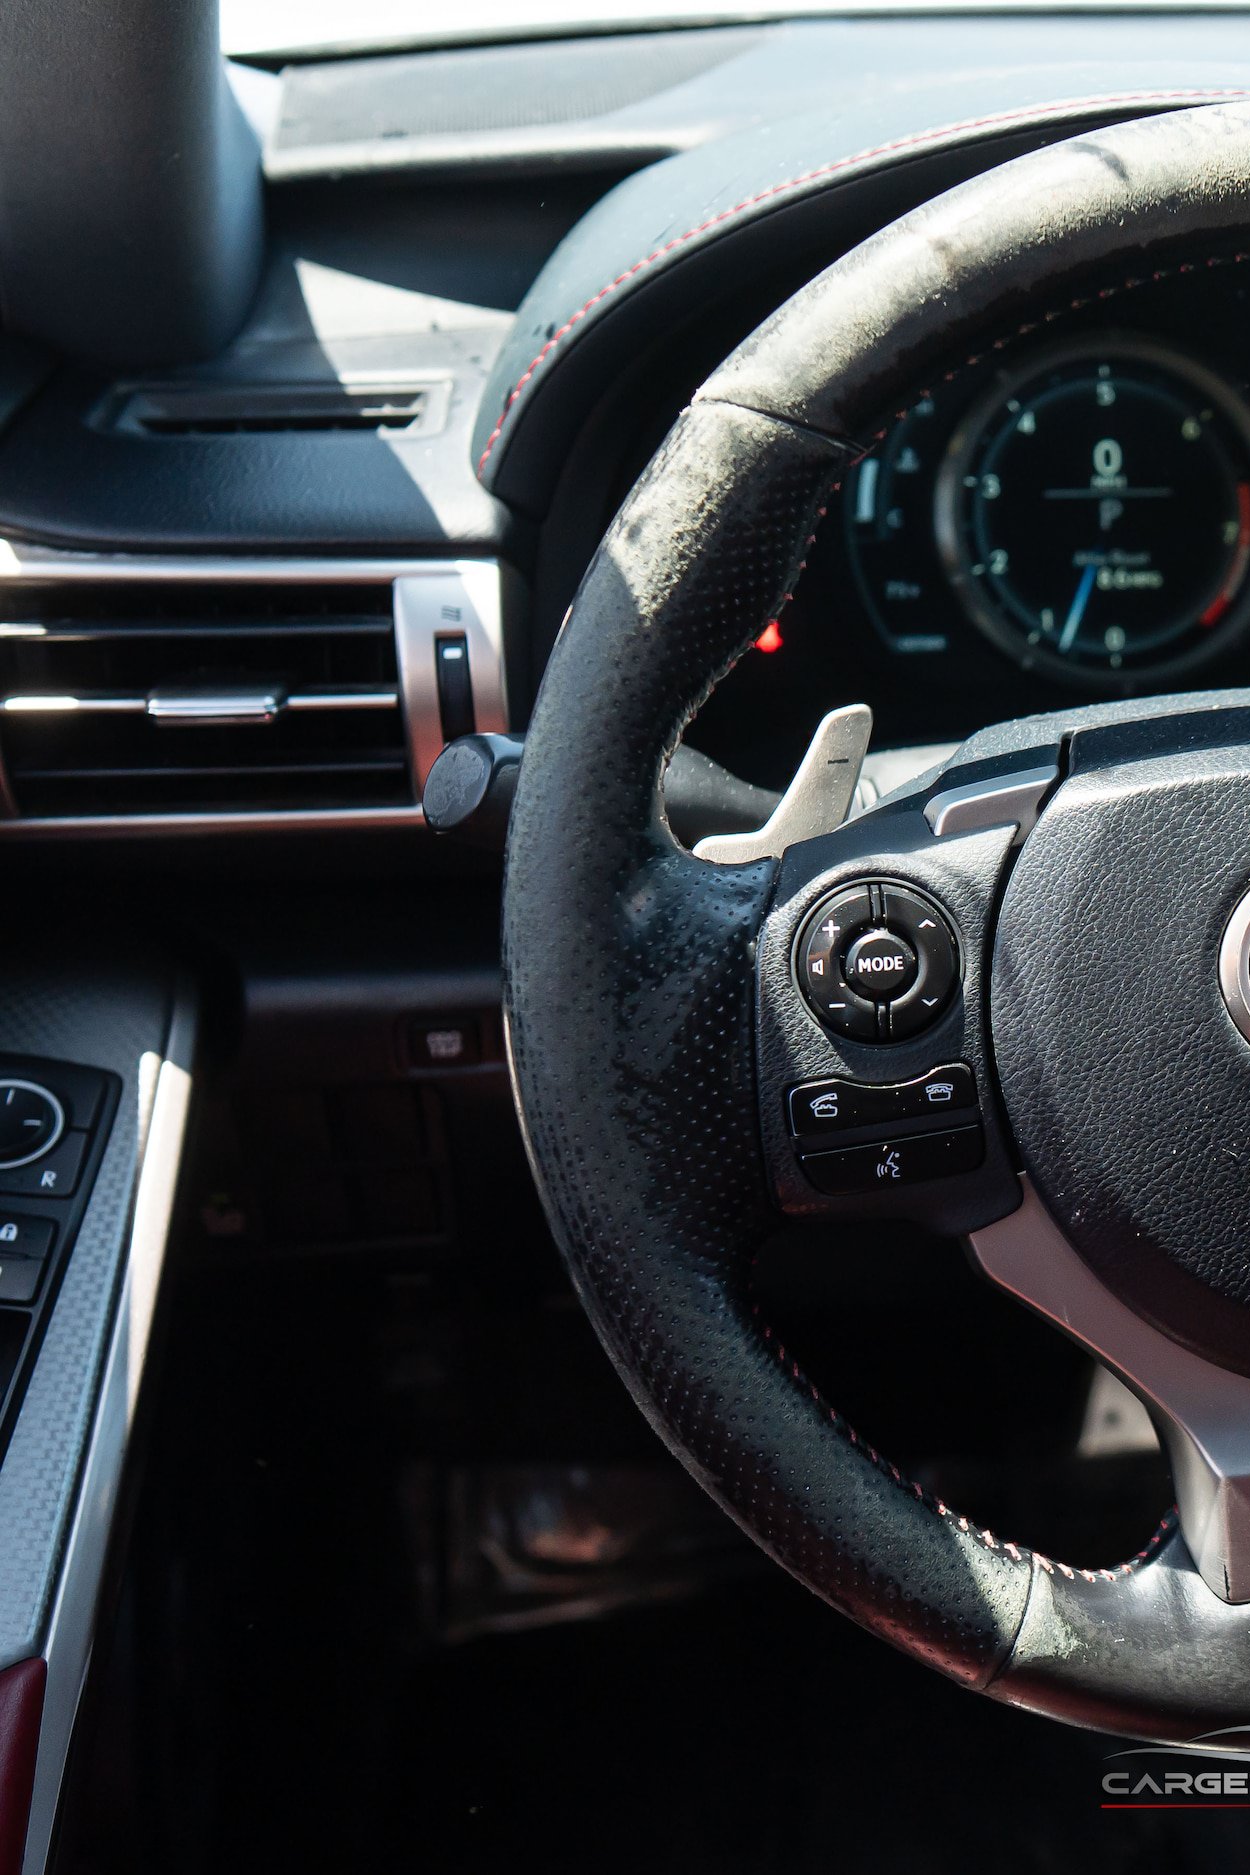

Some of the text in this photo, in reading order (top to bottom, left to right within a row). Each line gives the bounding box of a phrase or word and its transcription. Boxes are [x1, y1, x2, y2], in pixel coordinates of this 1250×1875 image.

[1093, 438, 1122, 475] 0
[989, 549, 1008, 575] 2
[857, 954, 905, 974] MODE
[40, 1169, 57, 1189] R
